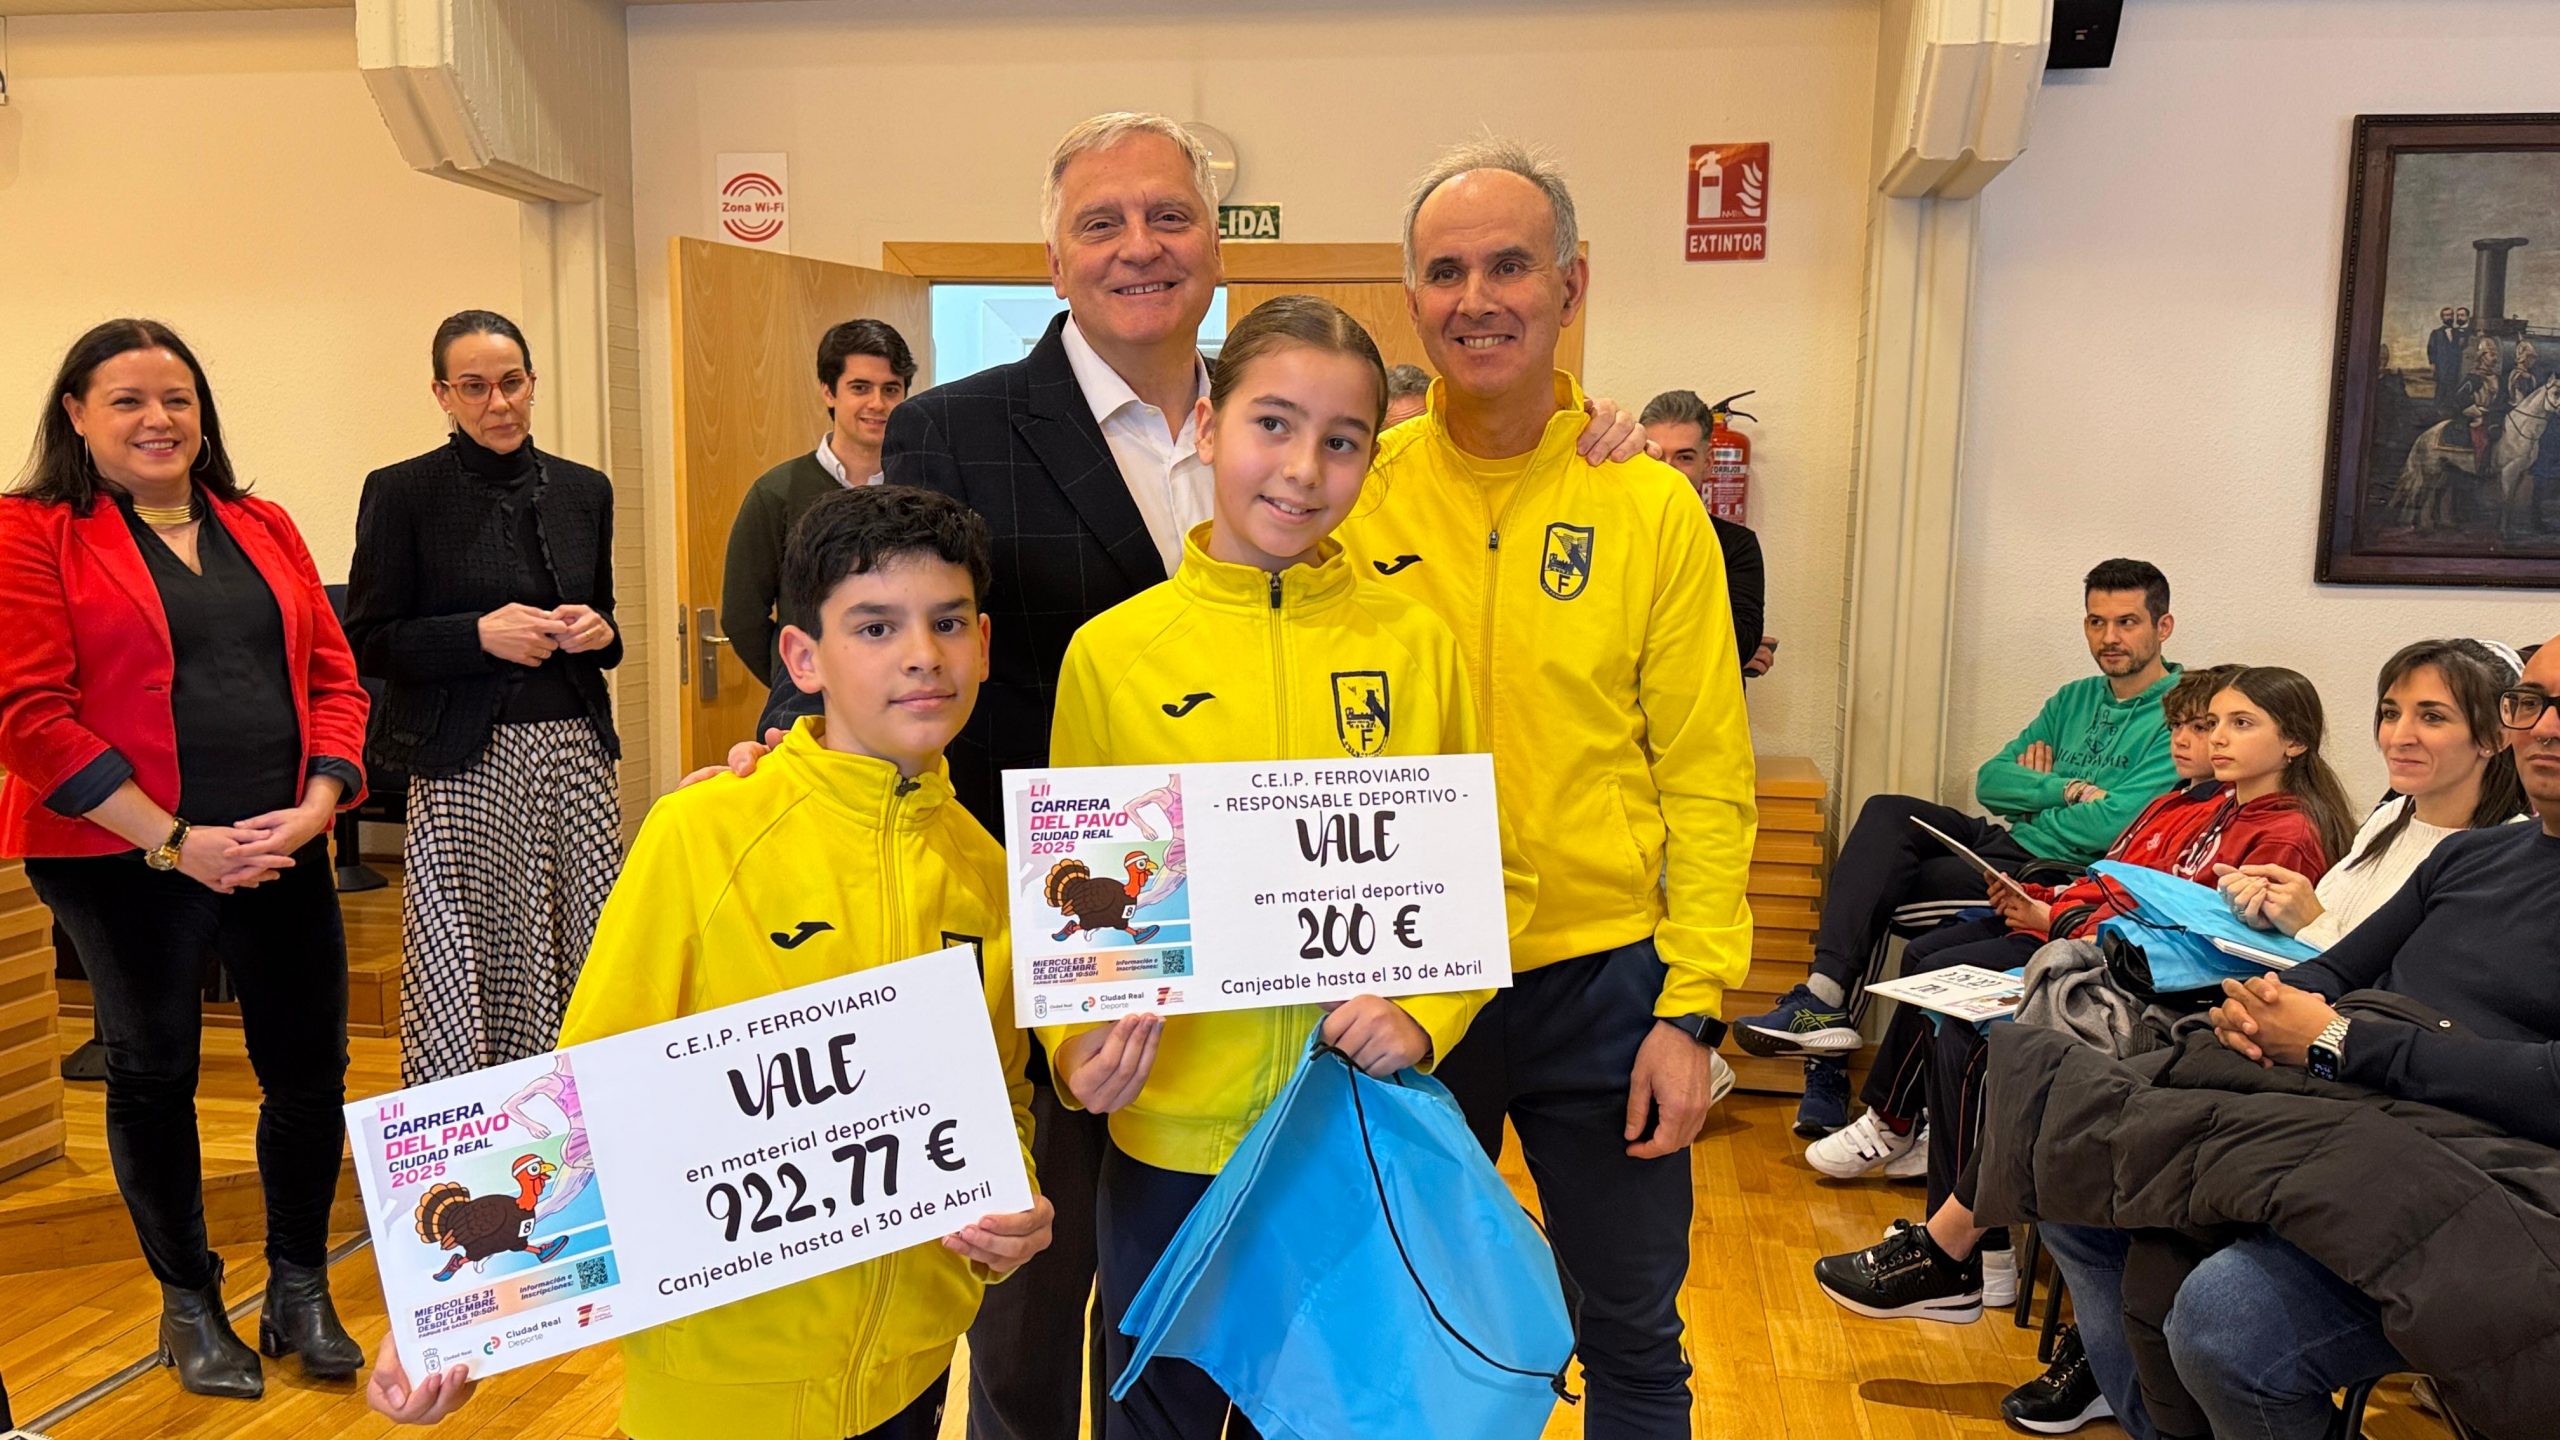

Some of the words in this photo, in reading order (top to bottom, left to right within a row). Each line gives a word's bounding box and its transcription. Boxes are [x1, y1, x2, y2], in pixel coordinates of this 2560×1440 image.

[722, 202, 751, 212] Zona
[755, 202, 784, 212] Wi-Fi
[1689, 233, 1762, 253] EXTINTOR
[1558, 574, 1570, 593] F
[1361, 729, 1373, 751] F
[1252, 772, 1309, 788] C.E.I.P.
[1315, 768, 1430, 785] FERROVIARIO
[1030, 784, 1050, 797] LII
[1227, 792, 1352, 812] RESPONSABLE
[1359, 788, 1457, 806] DEPORTIVO
[1031, 798, 1110, 813] CARRERA
[1030, 815, 1070, 830] DEL
[1074, 812, 1129, 828] PAVO
[1031, 830, 1079, 842] CIUDAD
[1083, 829, 1113, 839] REAL
[1295, 810, 1400, 868] VALE
[1031, 841, 1076, 855] 2025
[1254, 892, 1275, 905] en
[1282, 885, 1355, 903] material
[1362, 880, 1445, 902] deportivo
[1126, 907, 1133, 917] 8
[1298, 903, 1376, 960] 200
[1393, 904, 1423, 949] €
[1033, 957, 1084, 968] MIERCOLES
[1033, 967, 1046, 975] DE
[1048, 964, 1097, 973] DICIEMBRE
[1221, 973, 1311, 995] Canjeable
[1317, 970, 1366, 987] hasta
[1372, 968, 1386, 982] el
[1393, 966, 1412, 980] 30
[1418, 963, 1438, 979] de
[1444, 960, 1482, 977] Abril
[1100, 994, 1126, 1002] Ciudad
[1128, 992, 1144, 1000] Real
[1100, 1002, 1129, 1011] Deporte
[666, 1028, 741, 1059] C.E.I.P.
[747, 986, 897, 1039] FERROVIARIO
[727, 1033, 866, 1120] VALE
[380, 1103, 404, 1121] LII
[384, 1102, 484, 1139] CARRERA
[386, 1135, 436, 1160] DEL
[442, 1113, 509, 1146] PAVO
[686, 1165, 714, 1183] en
[722, 1131, 818, 1172] material
[825, 1102, 931, 1143] deportivo
[389, 1148, 448, 1173] CIUDAD
[454, 1138, 492, 1156] REAL
[392, 1162, 446, 1188] 2025
[706, 1134, 900, 1242] 922,77
[925, 1119, 966, 1172] €
[523, 1222, 531, 1233] 8
[658, 1250, 773, 1296] Canjeable
[780, 1229, 844, 1260] hasta
[851, 1218, 870, 1238] el
[876, 1209, 903, 1231] 30
[910, 1197, 936, 1220] de
[943, 1181, 992, 1211] Abril
[520, 1276, 566, 1293] Información
[521, 1281, 574, 1300] Inscripciones:
[415, 1294, 479, 1318] MIERCOLES
[483, 1289, 494, 1299] 31
[416, 1315, 432, 1326] DE
[435, 1297, 496, 1321] DICIEMBRE
[418, 1320, 447, 1333] DESDE
[450, 1314, 468, 1324] LAS
[470, 1305, 499, 1317] 10:50H
[506, 1324, 539, 1339] Ciudad
[541, 1317, 562, 1329] Real
[507, 1333, 543, 1349] Deporte
